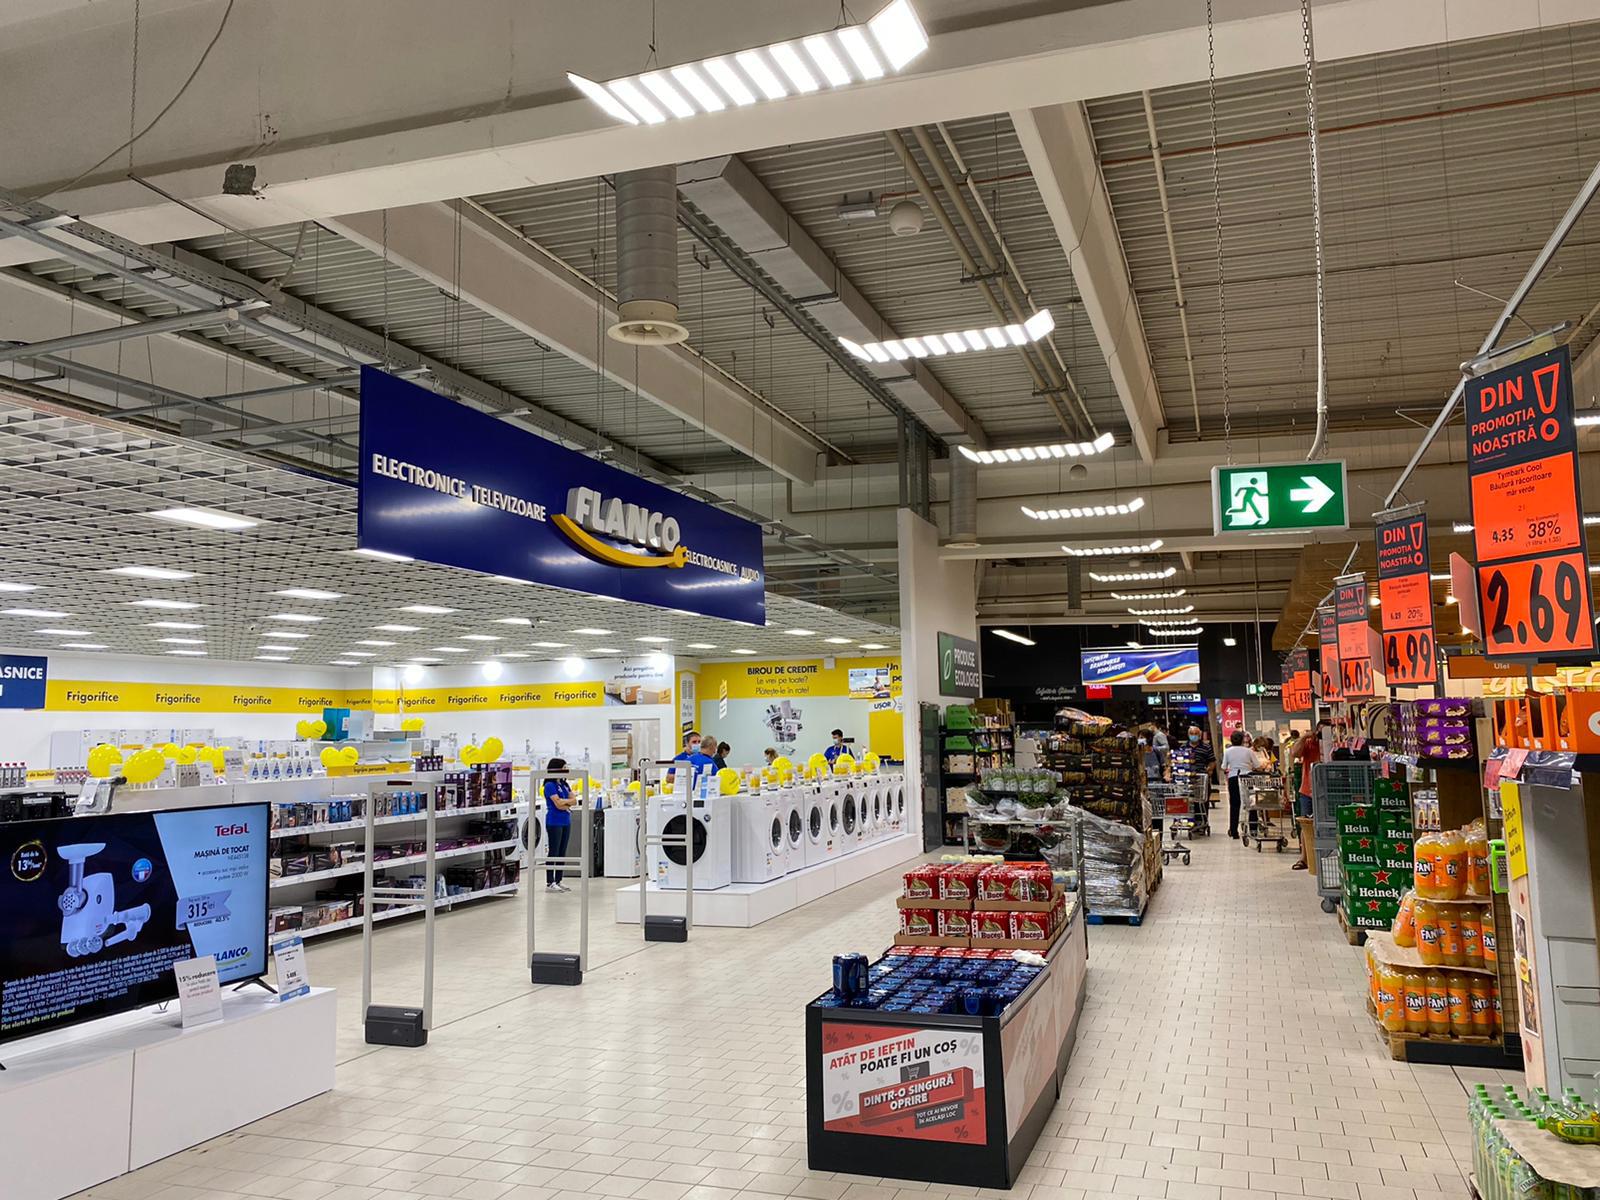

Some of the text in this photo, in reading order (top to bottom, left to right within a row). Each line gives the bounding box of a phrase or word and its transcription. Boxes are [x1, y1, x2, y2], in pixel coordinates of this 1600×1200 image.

[1480, 376, 1523, 413] DIN
[1471, 407, 1536, 437] PROMOȚIA
[1472, 424, 1538, 456] NOASTRĂ
[1526, 463, 1542, 473] Cool
[372, 453, 546, 522] ELECTRONICE TELEVIZOARE
[566, 486, 681, 553] FLANCO
[1383, 526, 1406, 545] DIN
[1492, 527, 1514, 543] 4.35
[1528, 519, 1561, 539] 38%
[686, 549, 738, 577] ELECTROCASNICE
[1487, 561, 1582, 645] 2.69
[954, 648, 975, 667] PRODUSE
[1387, 632, 1432, 678] 4.99
[747, 665, 817, 675] BIROU DE CREDITE
[954, 669, 979, 687] ECOLOGICE
[1343, 660, 1371, 692] 6.05
[67, 691, 119, 704] Frigorifice
[156, 693, 201, 705] Frigorifice
[233, 695, 272, 706] Frigorifice
[299, 697, 333, 707] Frigorifice
[397, 697, 436, 707] Frigorifice
[448, 695, 488, 705] Frigorifice
[500, 693, 541, 702] Frigorifice
[554, 690, 597, 701] Frigorifice
[214, 823, 250, 837] Tefal
[1345, 825, 1370, 833] Hein
[231, 845, 249, 853] TOCAT
[1349, 854, 1374, 863] Hein
[946, 888, 968, 897] Bucegi
[188, 902, 207, 919] 315
[909, 925, 931, 934] Bucegi
[946, 923, 968, 932] Bucegi
[830, 1038, 915, 1070] ATÂT DE IEFTIN
[860, 1040, 957, 1074] POATE FI UN COȘ
[864, 1073, 954, 1107] DINTR-O SINGURĂ
[889, 1092, 928, 1110] OPRIRE
[946, 1110, 956, 1118] LOC
